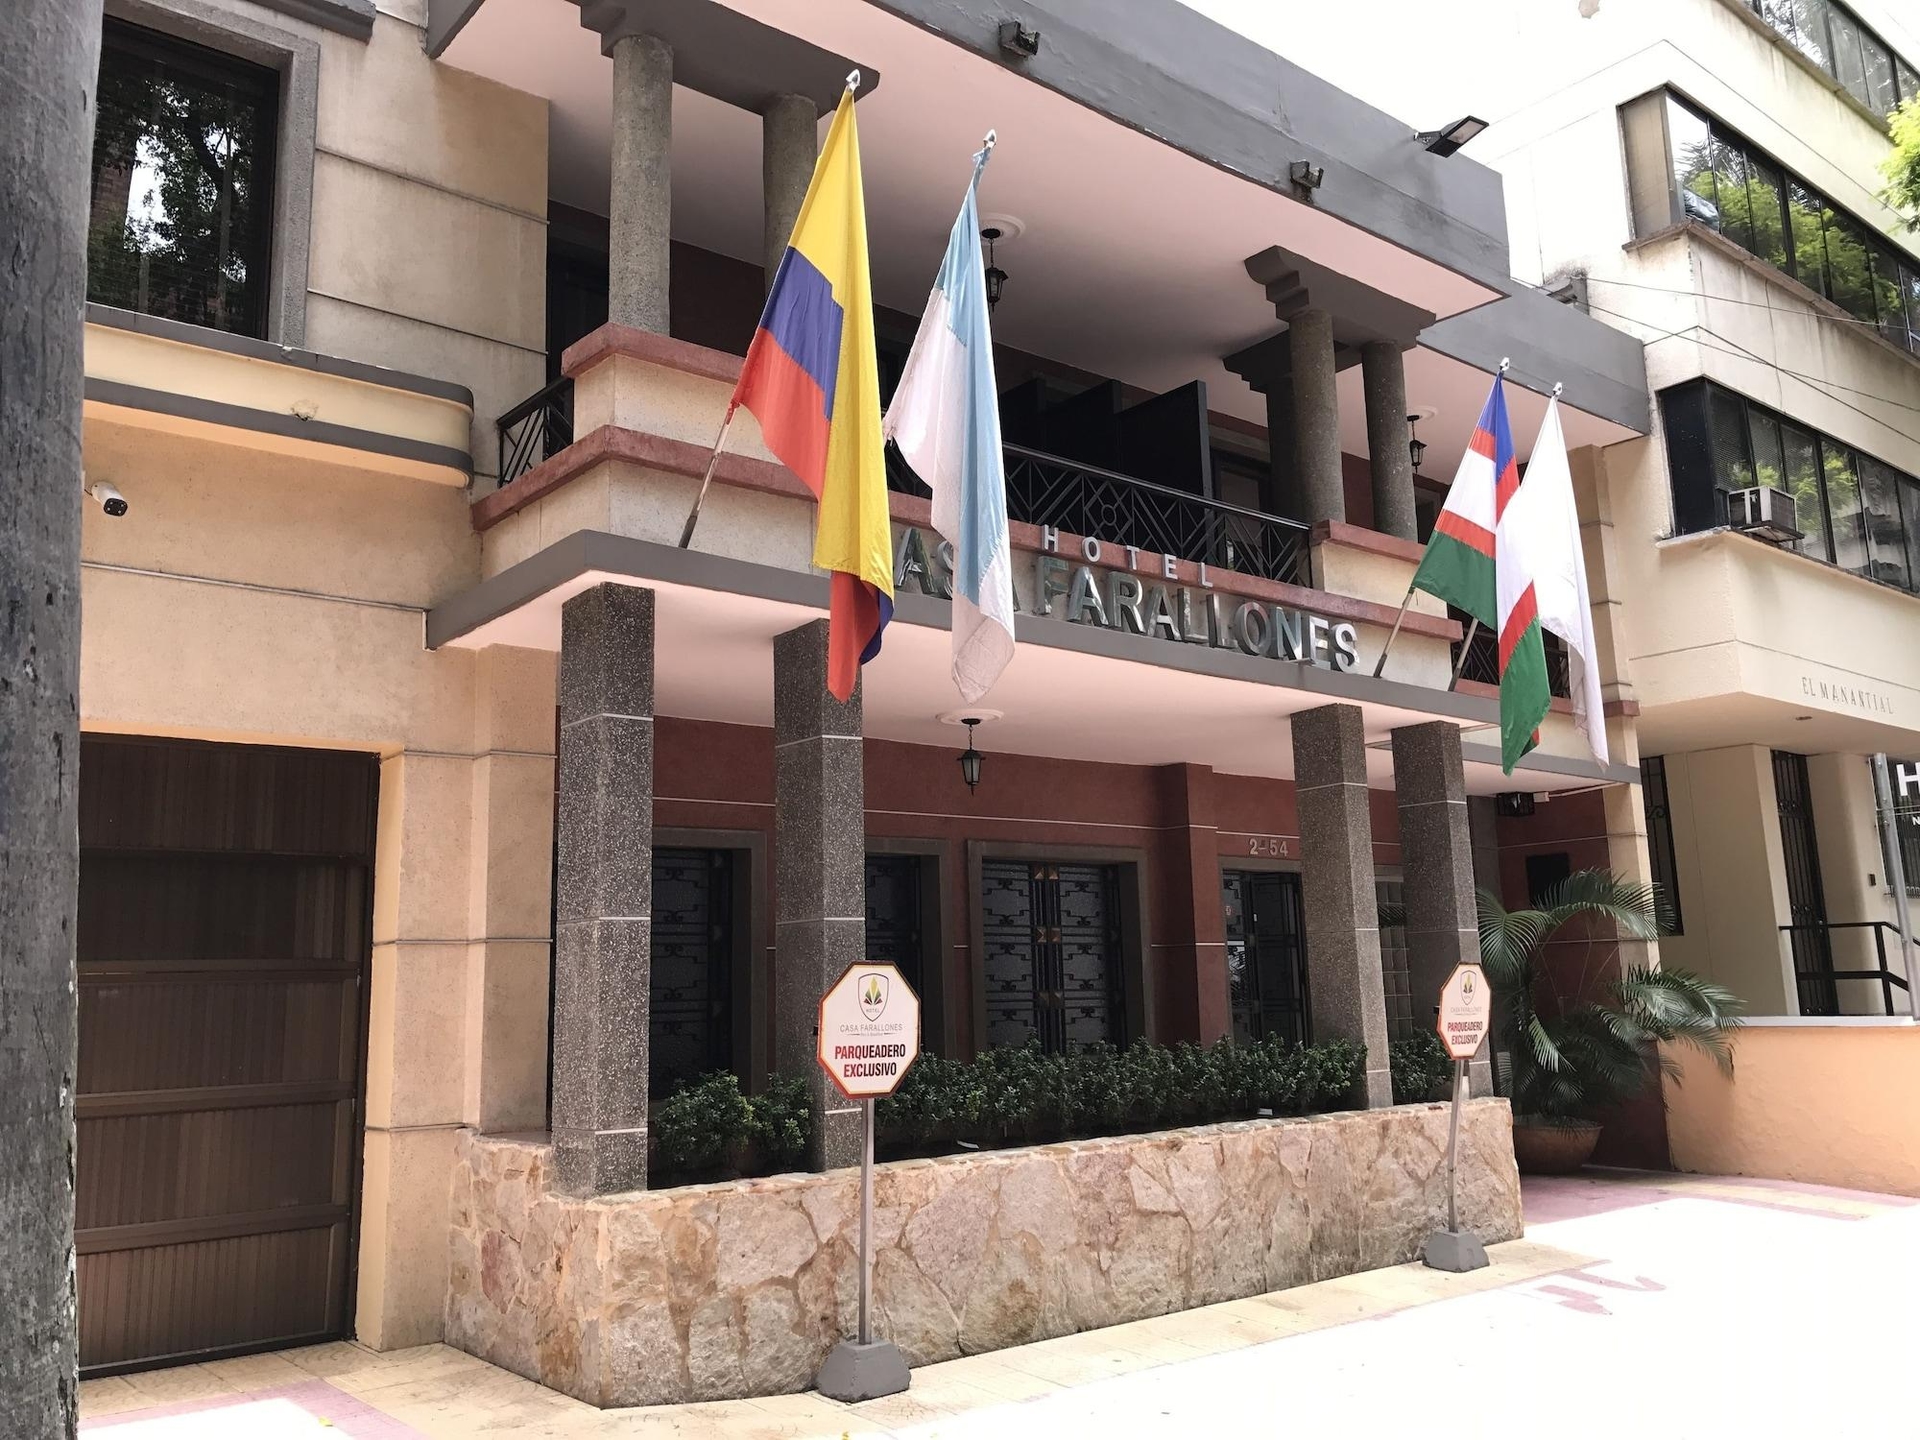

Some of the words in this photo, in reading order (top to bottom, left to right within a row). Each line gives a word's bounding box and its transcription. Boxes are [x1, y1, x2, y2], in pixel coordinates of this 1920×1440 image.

[1042, 524, 1214, 588] HOTEL
[1033, 555, 1360, 675] FARALLONES
[1801, 677, 1816, 697] EL
[1819, 681, 1894, 715] MANANTIAL
[1249, 838, 1288, 857] 2-54
[840, 1024, 858, 1032] CASA
[860, 1023, 903, 1032] FARALLONES
[1447, 1021, 1483, 1033] PARQUEADERO
[1451, 1034, 1478, 1046] EXCLUSIVO
[834, 1044, 906, 1060] PARQUEADERO
[843, 1062, 897, 1078] EXCLUSIVO
